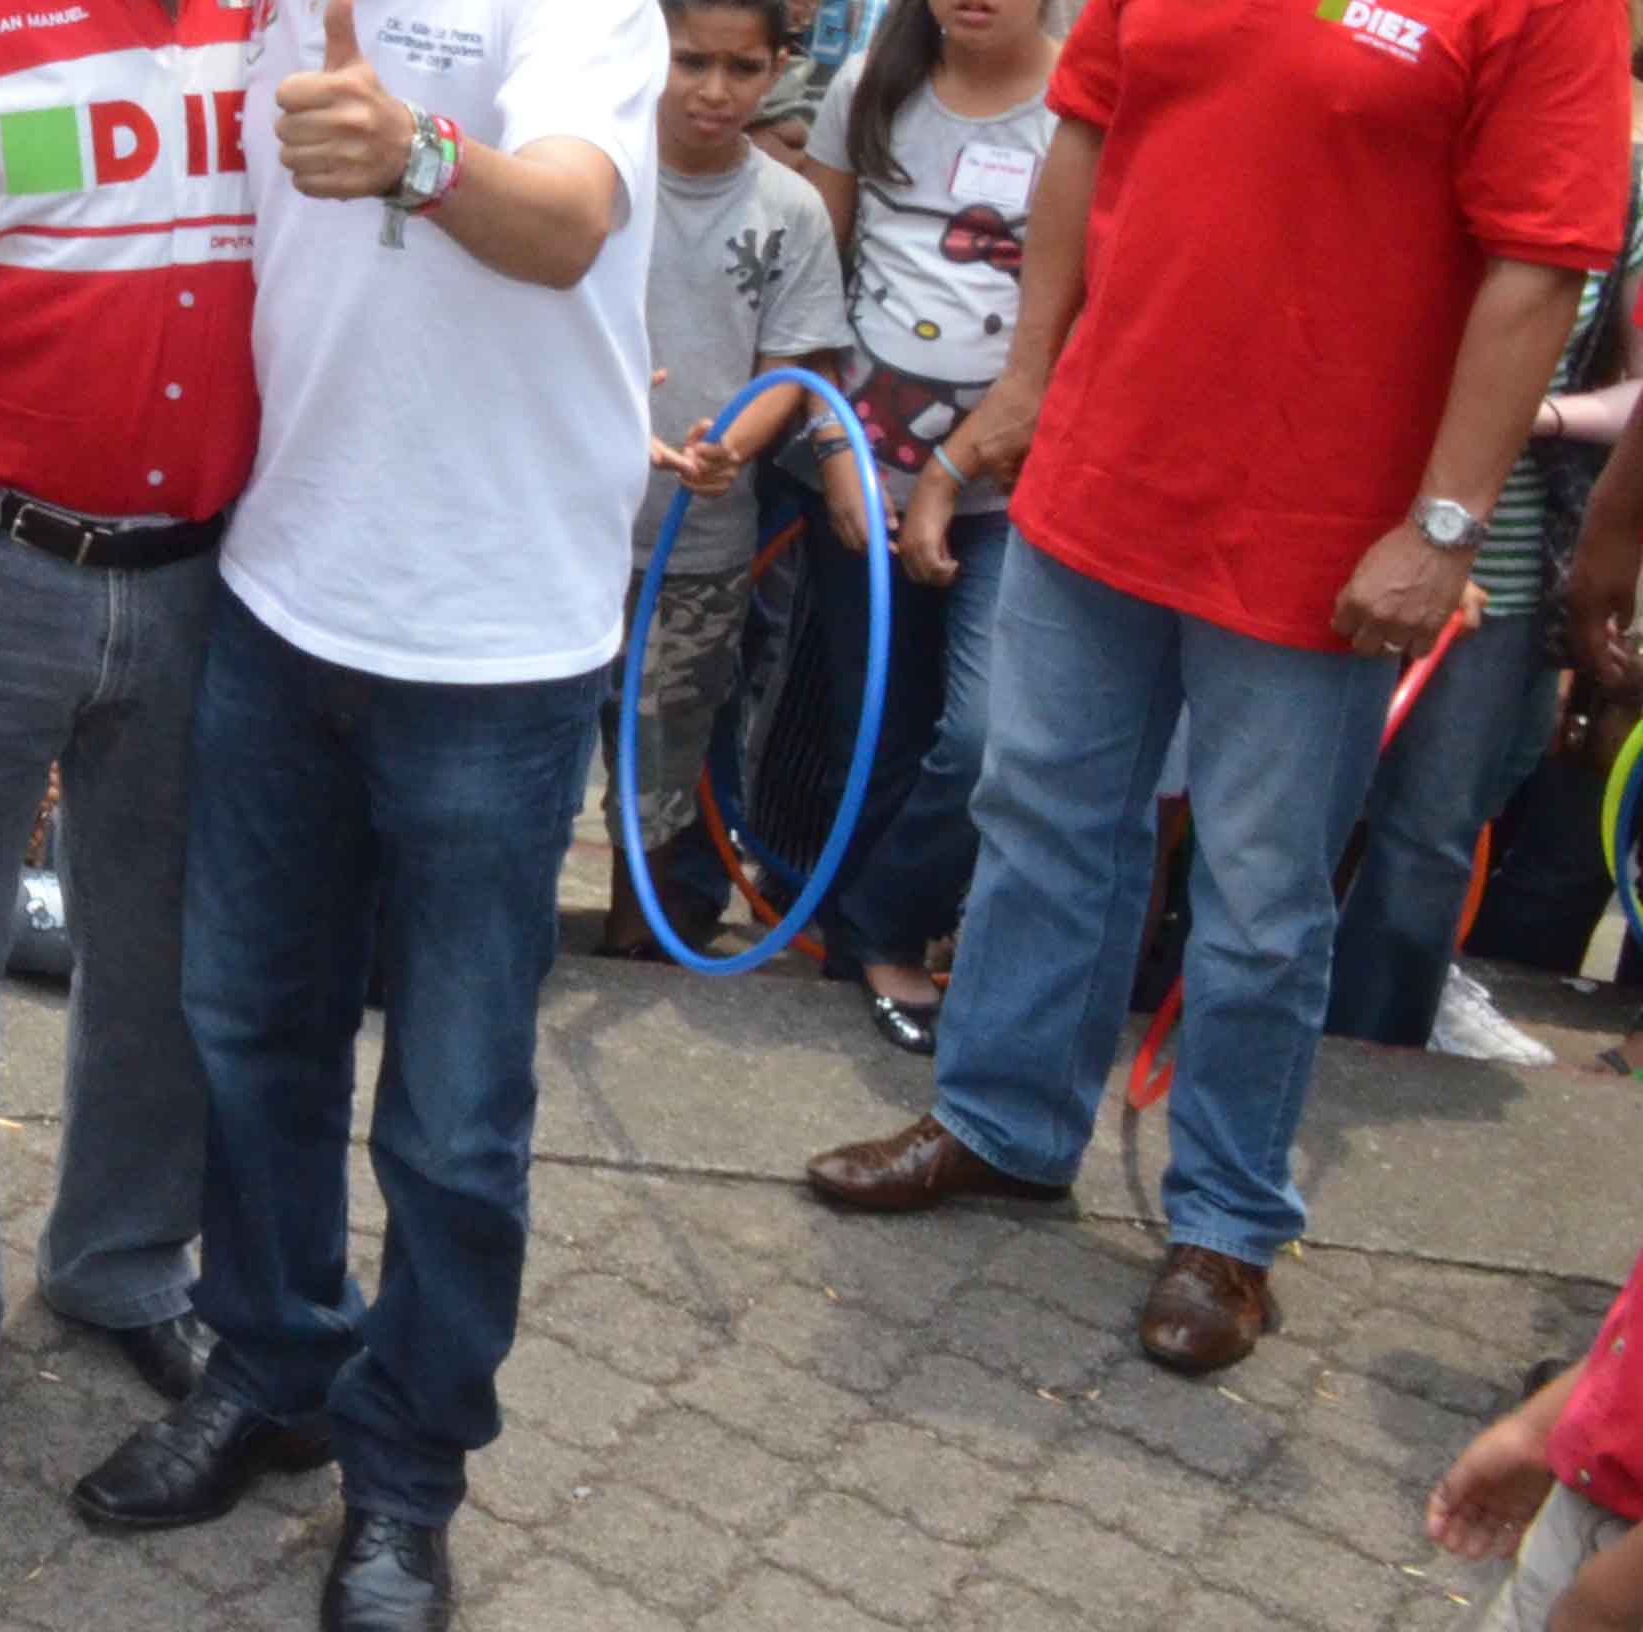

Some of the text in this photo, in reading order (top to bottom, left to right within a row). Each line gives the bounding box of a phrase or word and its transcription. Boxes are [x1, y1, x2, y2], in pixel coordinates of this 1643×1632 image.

[26, 6, 91, 28] MANUEL
[1341, 0, 1429, 53] DIEZ
[88, 89, 248, 187] DIE
